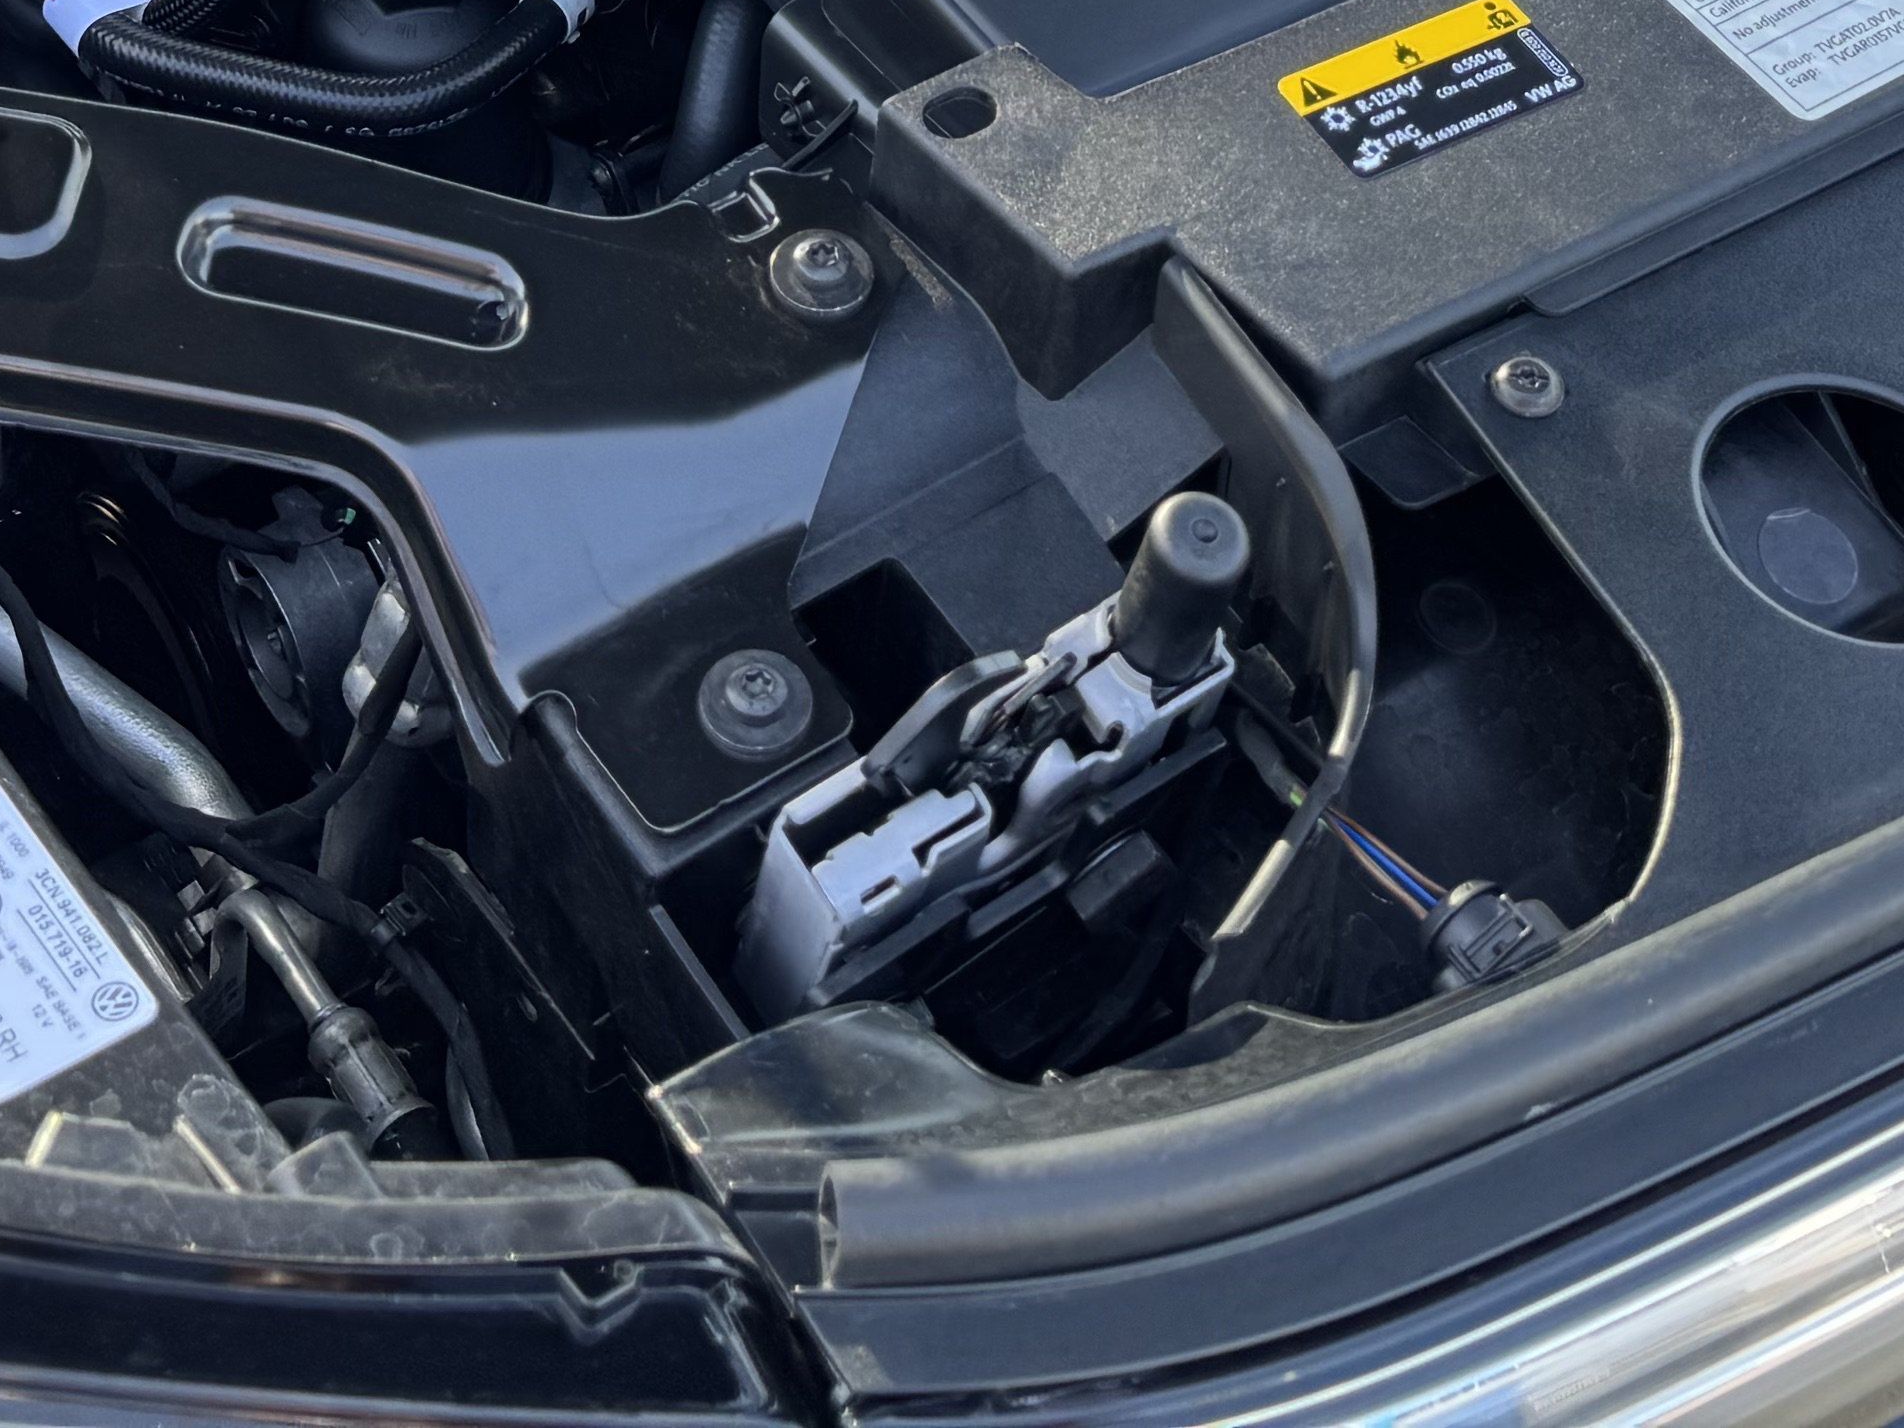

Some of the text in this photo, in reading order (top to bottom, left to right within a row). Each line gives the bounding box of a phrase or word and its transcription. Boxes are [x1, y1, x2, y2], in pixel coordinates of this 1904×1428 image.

[1730, 23, 1757, 40] No
[1770, 48, 1819, 78] Group:
[1783, 64, 1825, 90] Evap:
[1350, 75, 1429, 117] R-1234yf
[1481, 43, 1508, 63] kg
[1412, 133, 1438, 150] SAE
[1522, 83, 1556, 104] VW
[1548, 73, 1579, 93] AG
[1381, 122, 1424, 148] PAG
